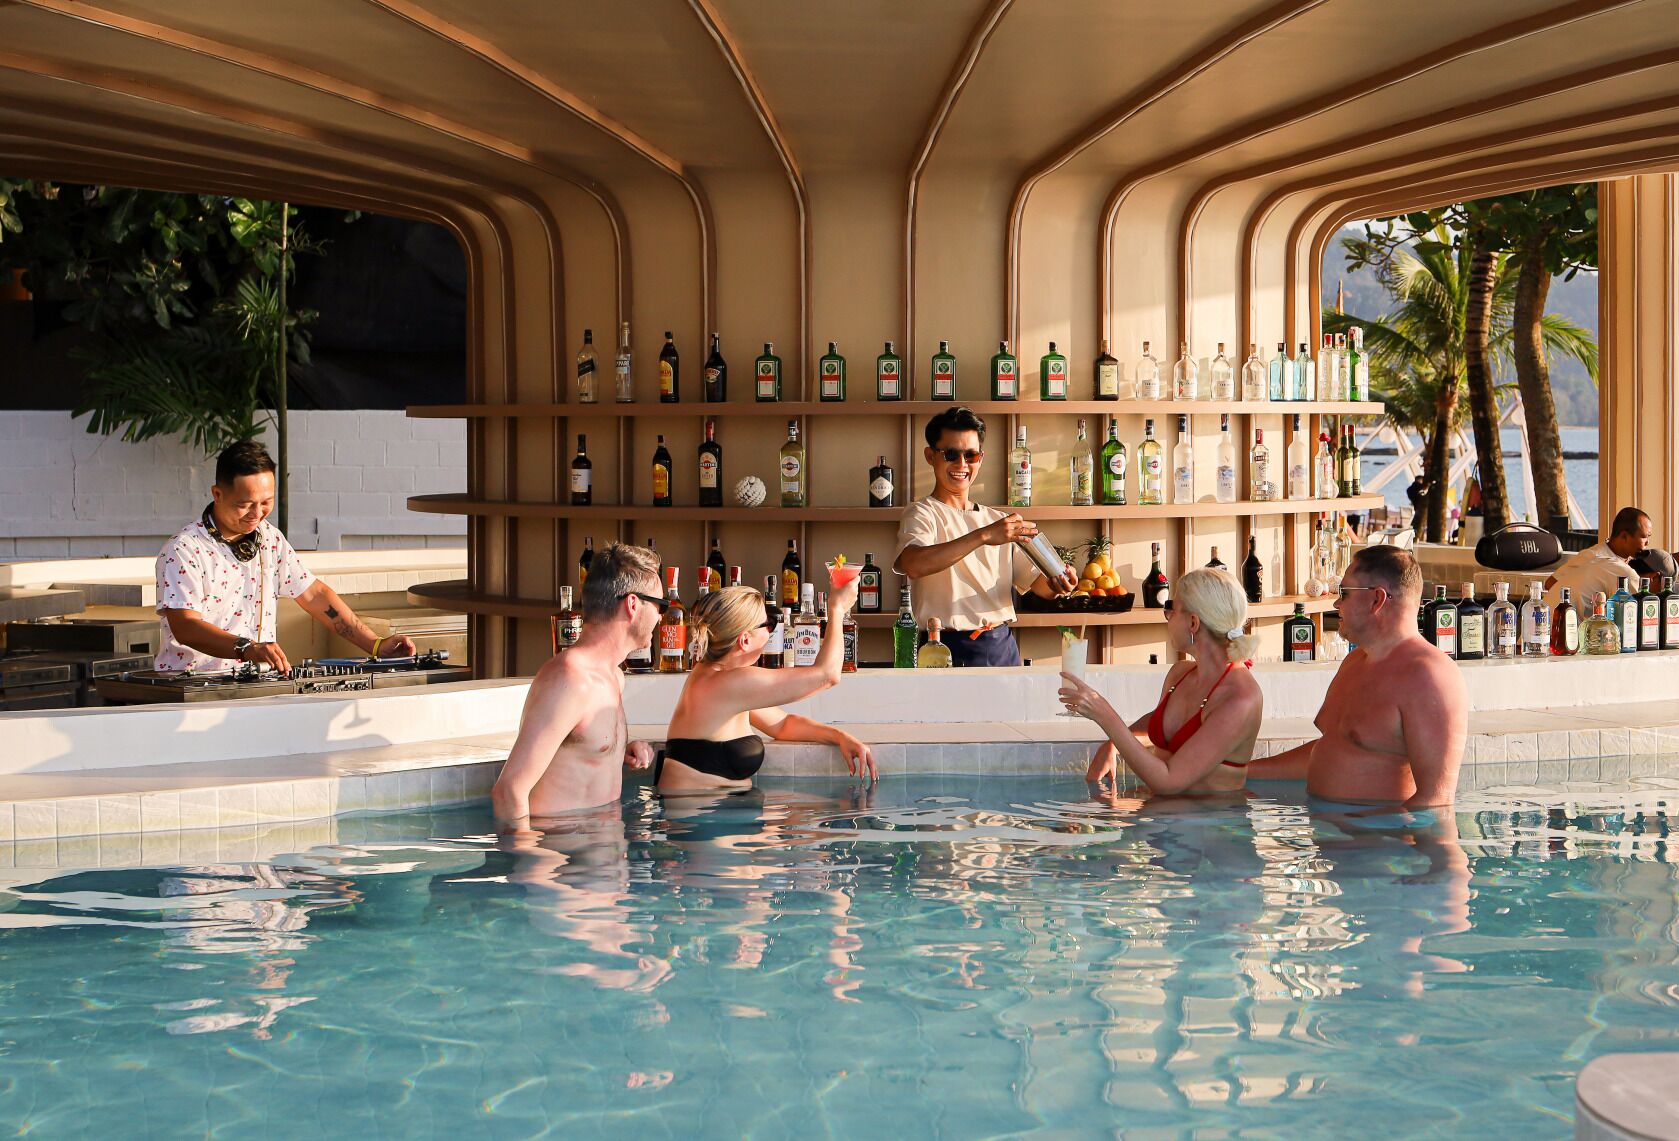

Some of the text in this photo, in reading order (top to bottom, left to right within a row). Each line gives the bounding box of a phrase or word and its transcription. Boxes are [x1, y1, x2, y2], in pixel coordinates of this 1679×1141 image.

[1521, 540, 1540, 554] JBL
[795, 628, 818, 639] JIM BEAM
